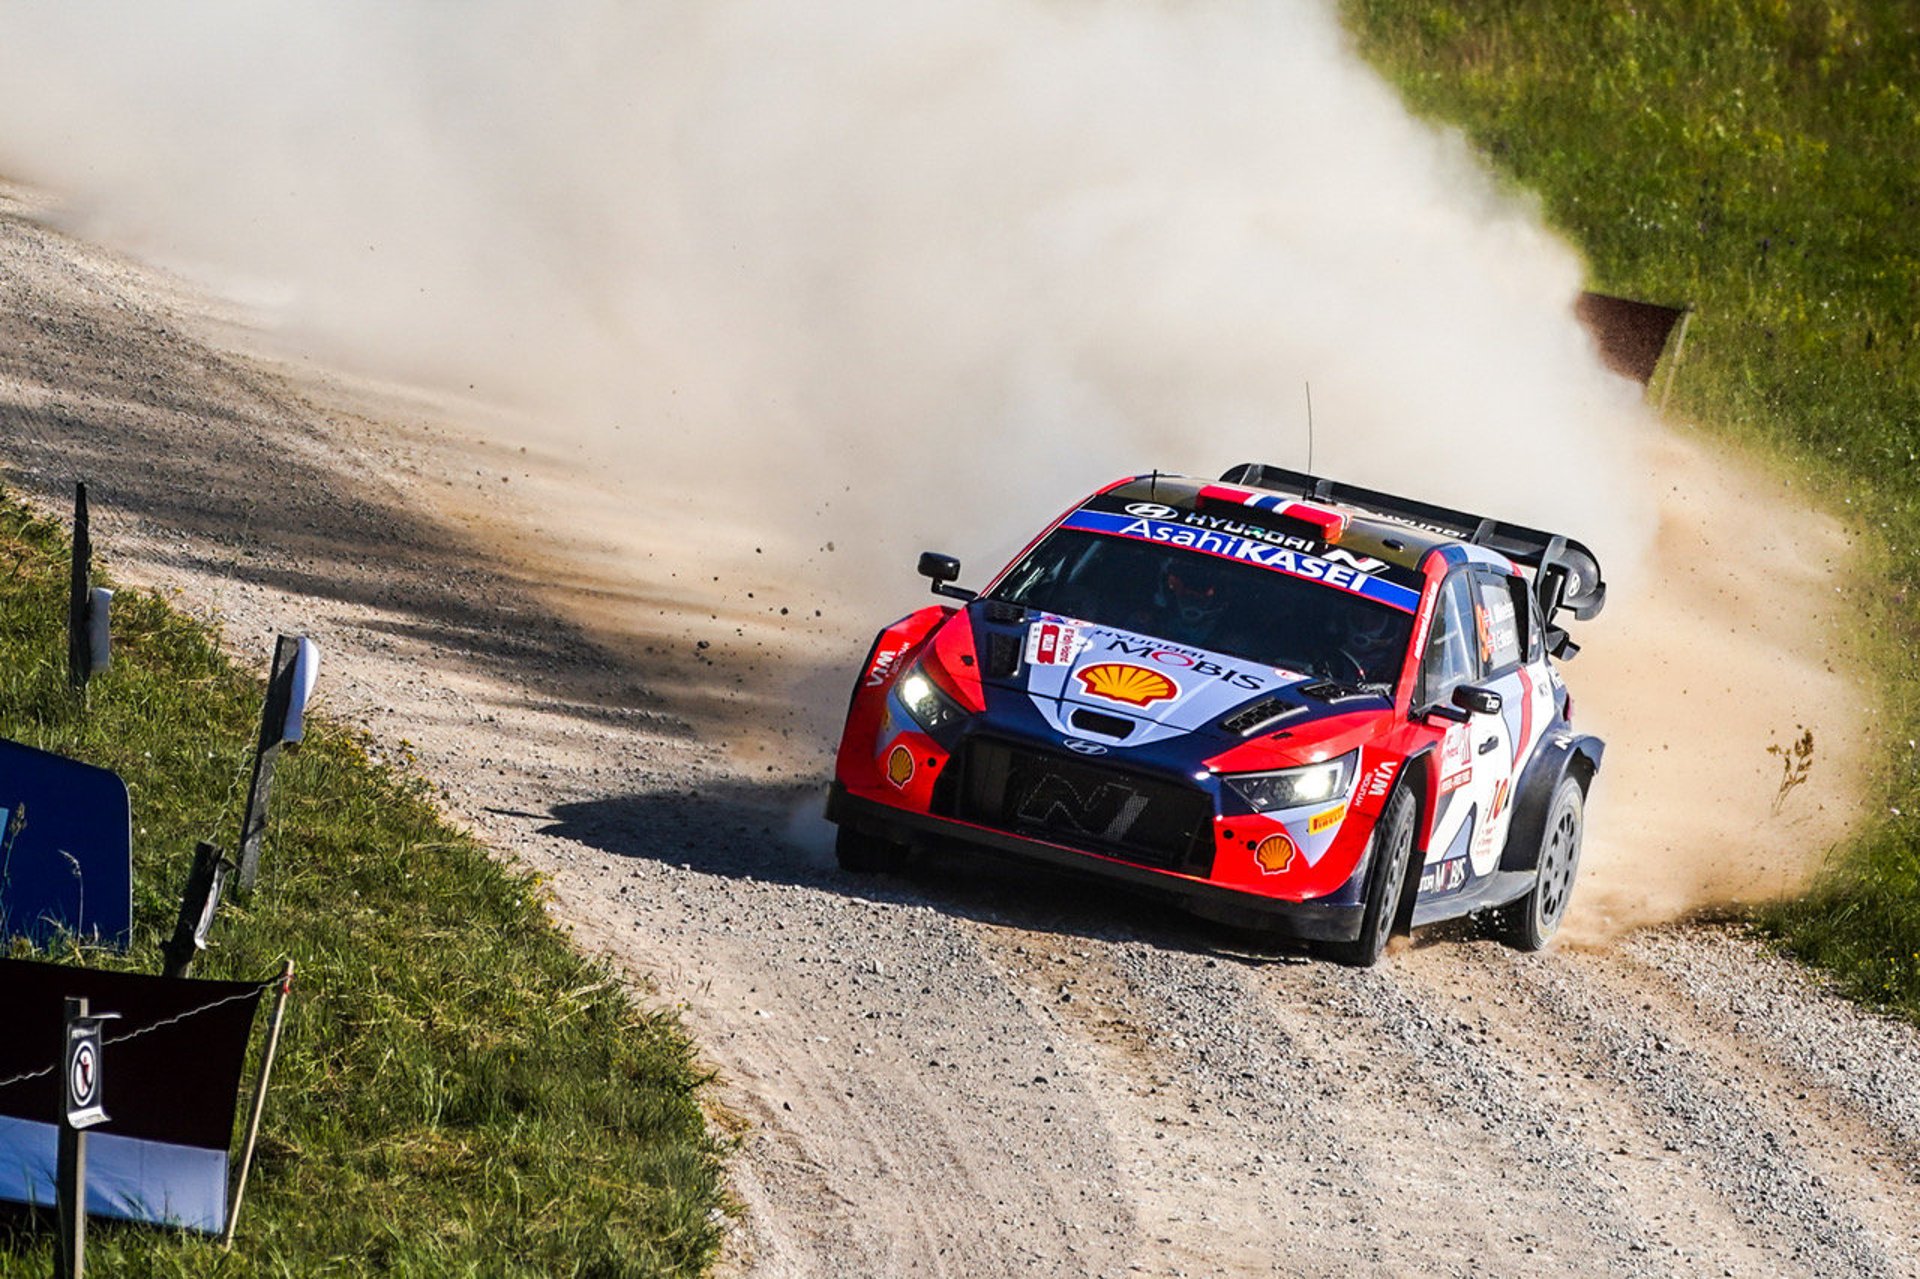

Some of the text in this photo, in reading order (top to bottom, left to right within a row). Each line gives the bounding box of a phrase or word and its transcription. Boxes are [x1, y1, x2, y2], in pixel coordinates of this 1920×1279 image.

[1185, 512, 1315, 552] HYUNDAI
[1120, 518, 1369, 592] AsahiKASEI
[1096, 630, 1205, 659] HYUNDAI
[1107, 640, 1265, 691] MOBIS
